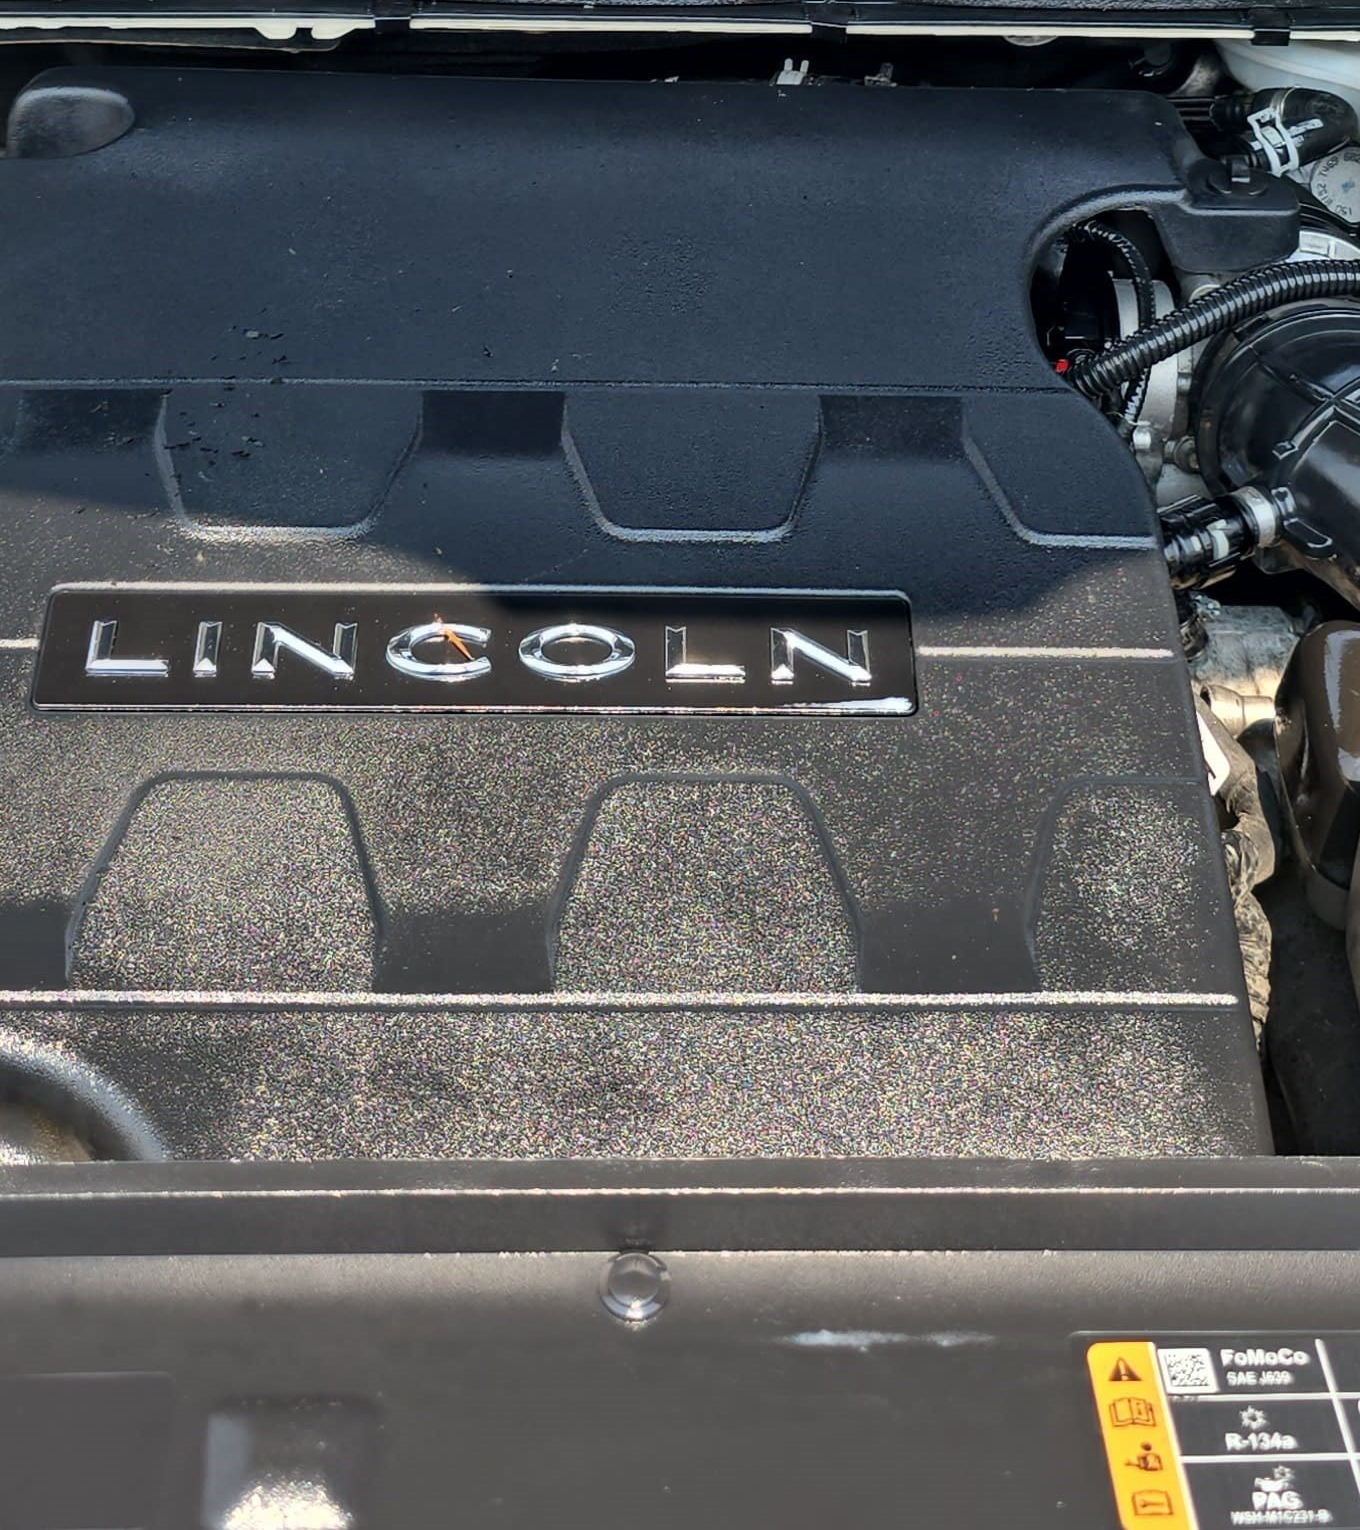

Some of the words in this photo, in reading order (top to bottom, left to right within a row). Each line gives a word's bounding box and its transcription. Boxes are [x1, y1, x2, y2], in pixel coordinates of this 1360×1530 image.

[81, 615, 873, 688] LINCOLN
[1220, 1347, 1311, 1366] FoMoCo
[1226, 1371, 1258, 1386] SAE
[1259, 1371, 1294, 1386] J639
[1224, 1432, 1300, 1451] R-134a
[1251, 1491, 1304, 1510] PAG
